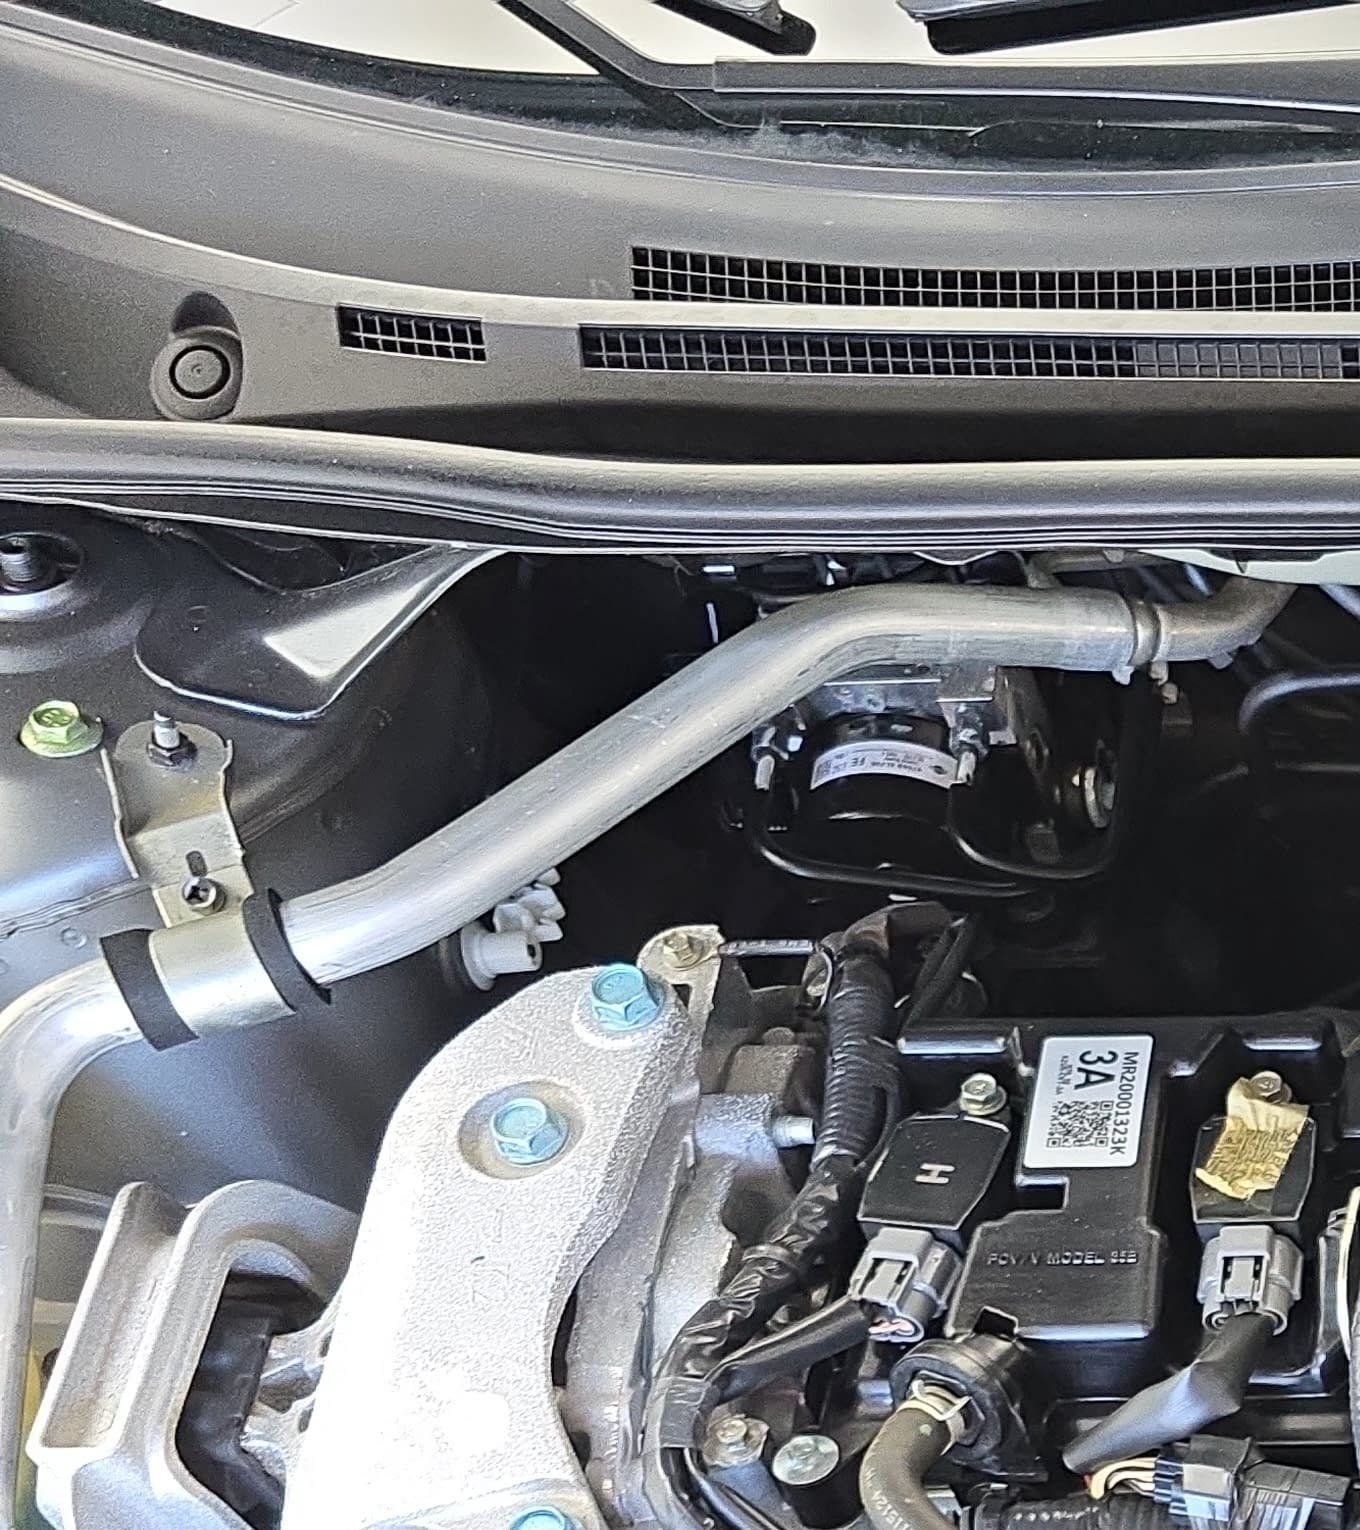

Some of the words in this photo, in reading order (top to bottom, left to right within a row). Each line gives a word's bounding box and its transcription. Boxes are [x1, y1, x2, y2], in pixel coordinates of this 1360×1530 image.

[1073, 1049, 1119, 1090] 3A
[1109, 1051, 1140, 1156] MR20001323K
[914, 1162, 956, 1185] H
[1046, 1251, 1106, 1265] MODEL
